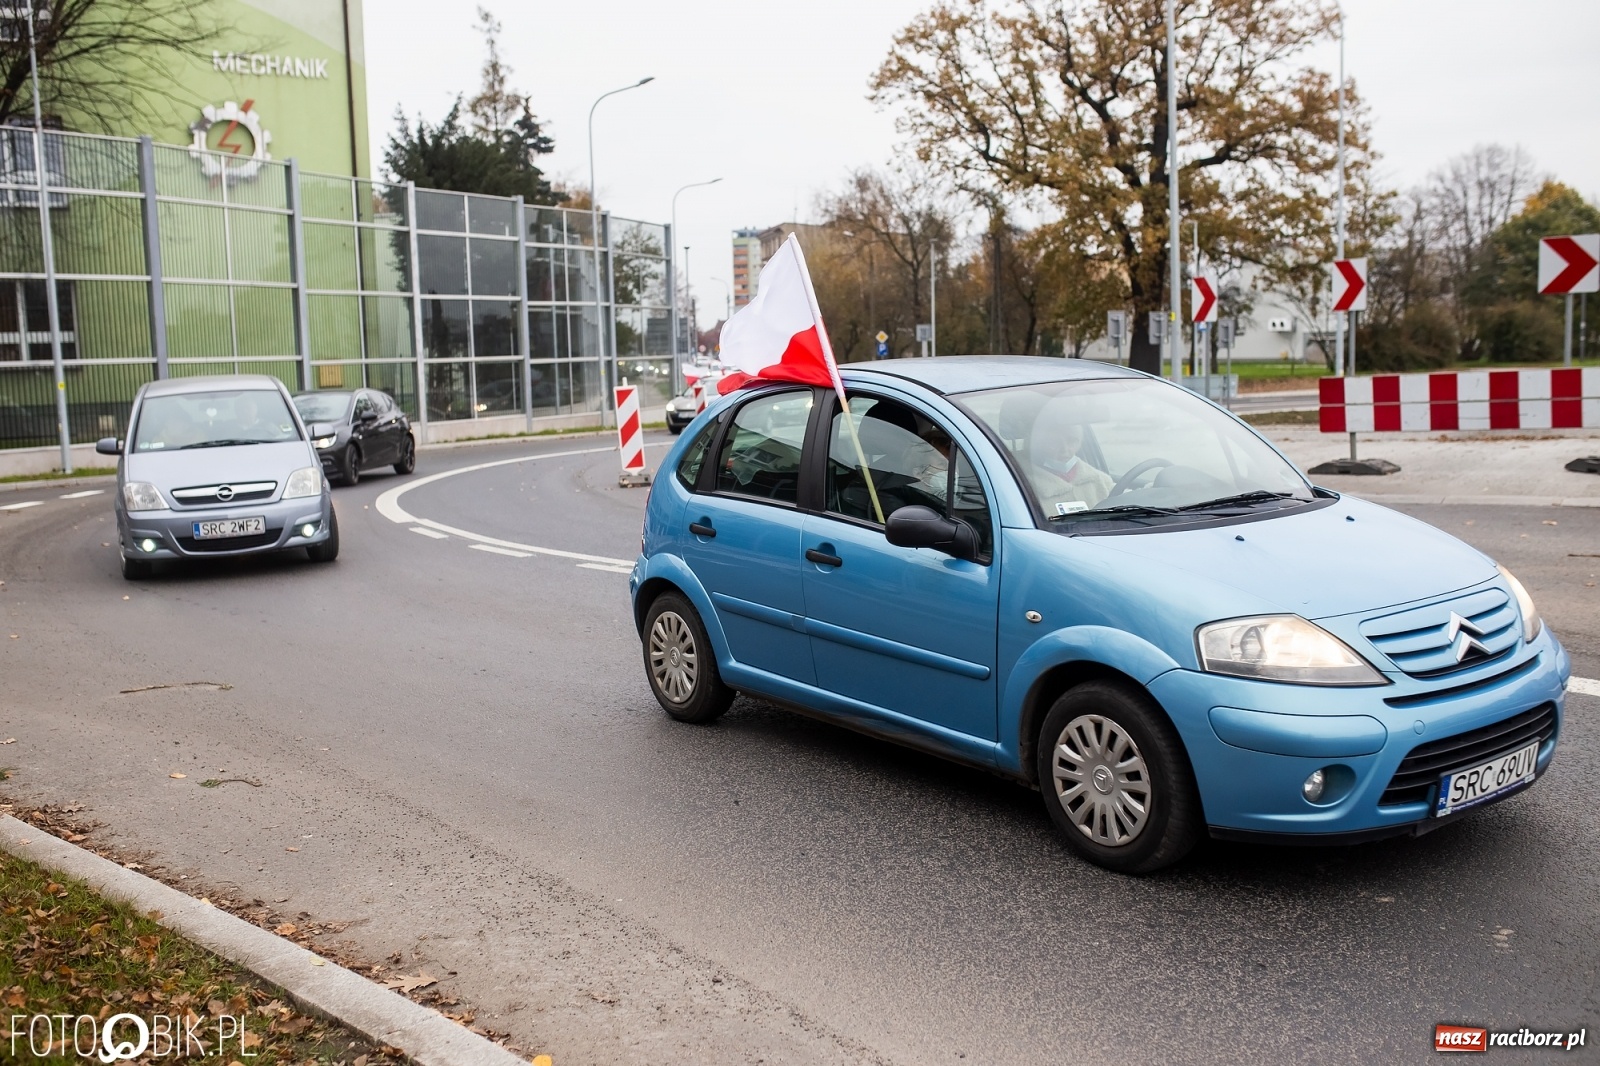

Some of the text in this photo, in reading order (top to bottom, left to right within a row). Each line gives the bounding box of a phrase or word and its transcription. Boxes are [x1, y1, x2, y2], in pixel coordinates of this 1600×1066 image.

[212, 50, 328, 79] MECHANIK
[202, 519, 261, 535] SRC 2WF2
[1451, 765, 1493, 802] SRC
[1496, 745, 1537, 787] 69UV
